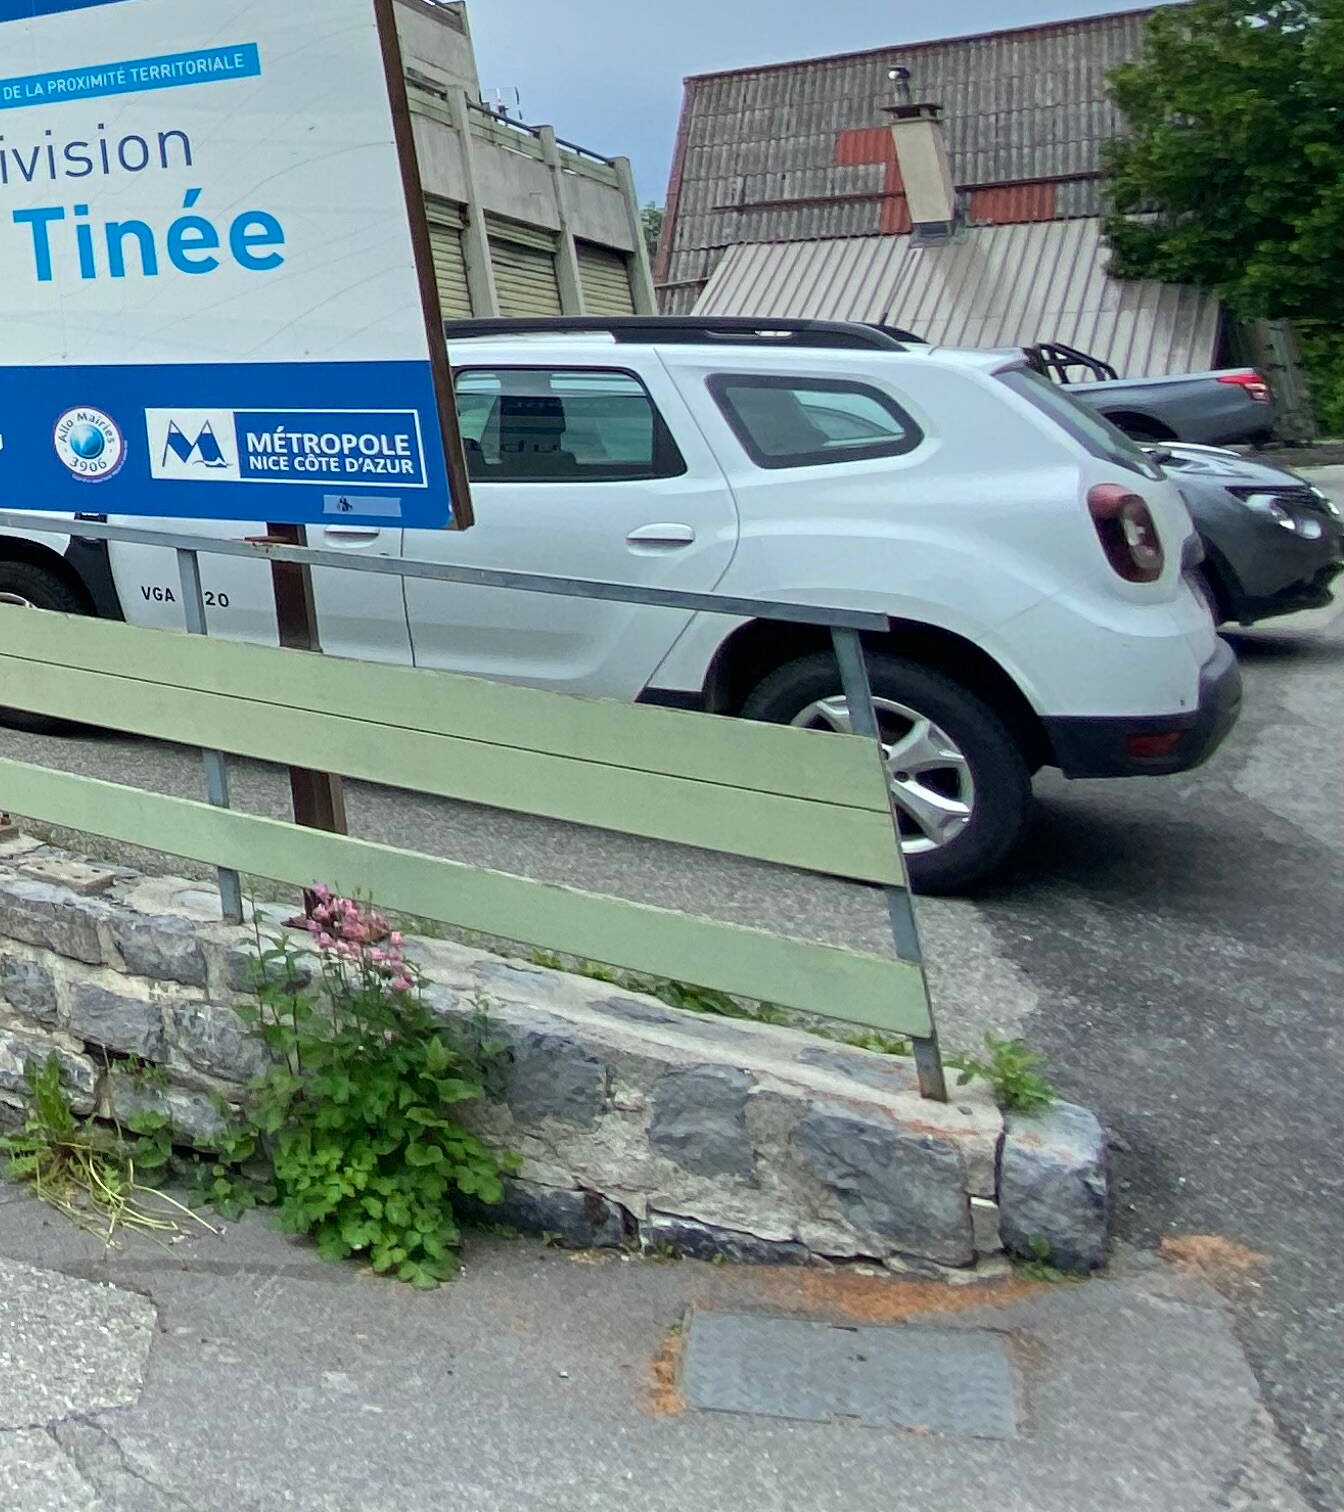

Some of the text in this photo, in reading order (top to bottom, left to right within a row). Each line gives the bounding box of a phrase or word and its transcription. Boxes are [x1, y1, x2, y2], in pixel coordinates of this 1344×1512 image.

[4, 85, 22, 100] DE
[25, 82, 44, 97] LA
[47, 66, 127, 95] PROXIMITÉ
[130, 52, 245, 82] TERRITORIALE
[12, 187, 286, 282] Tinée
[58, 412, 115, 444] Allo Mairies
[246, 426, 411, 456] MÉTROPOLE
[69, 456, 107, 472] 3906
[249, 454, 415, 474] NICE CÔTE D'AZUR
[140, 585, 176, 602] VGA
